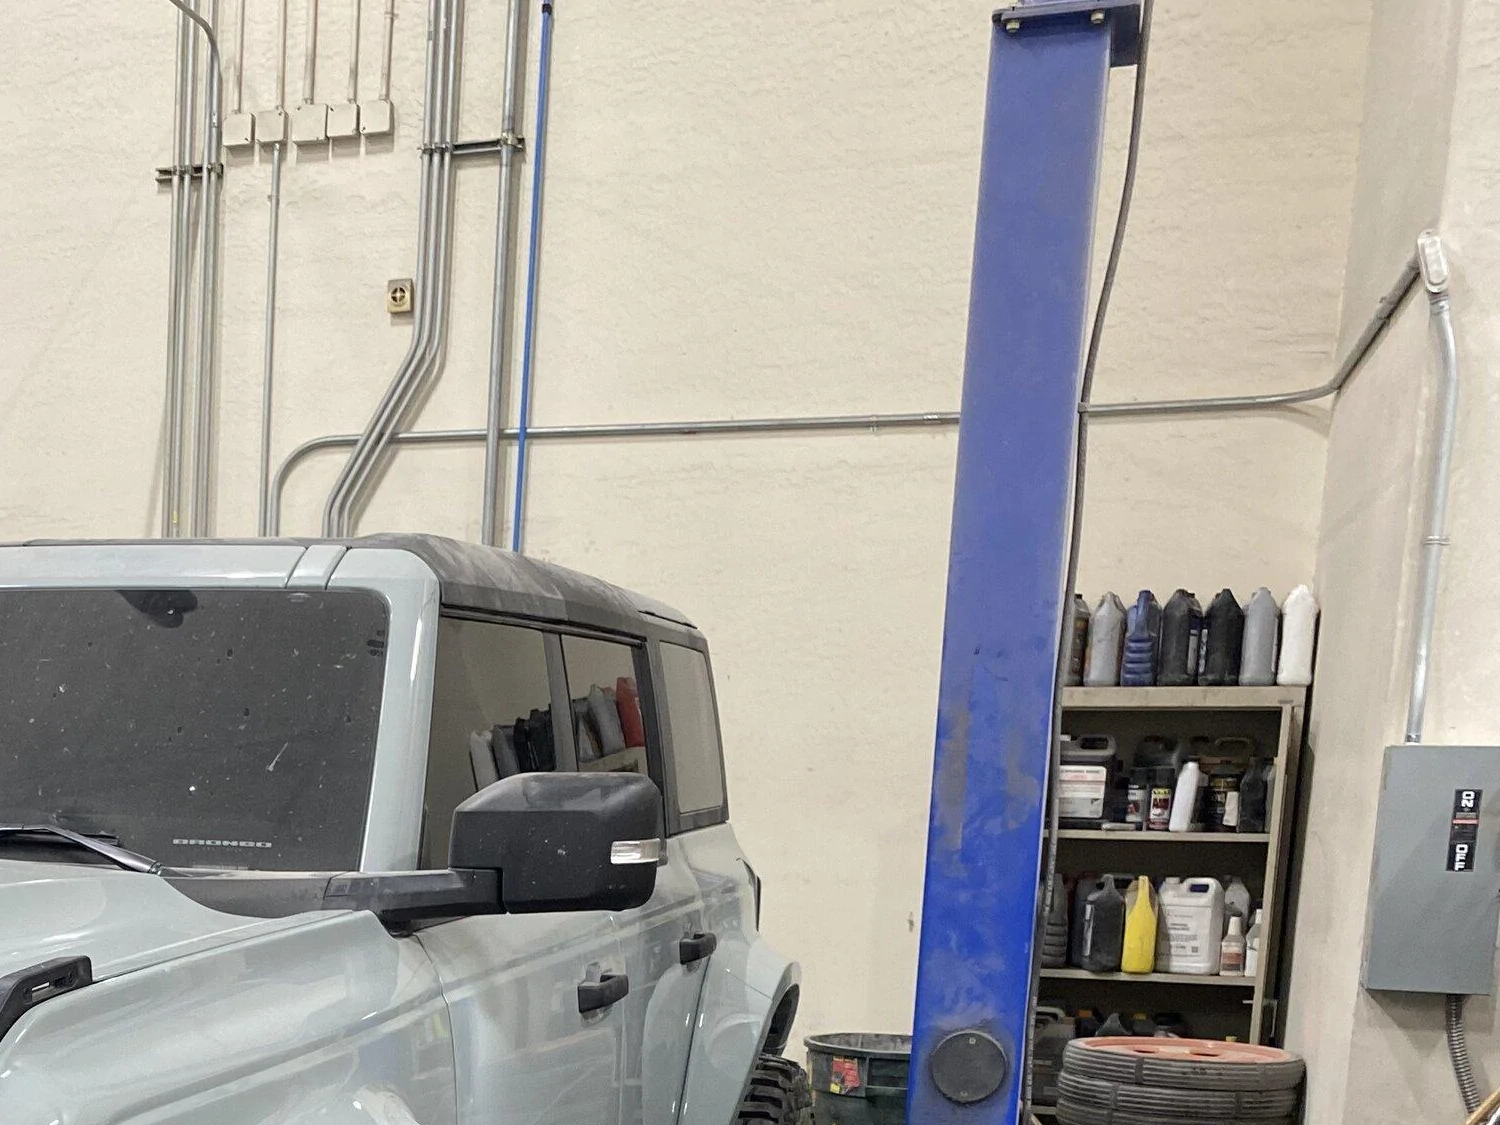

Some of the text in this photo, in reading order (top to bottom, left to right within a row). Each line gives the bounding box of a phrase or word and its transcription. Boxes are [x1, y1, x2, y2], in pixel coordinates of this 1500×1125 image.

[1461, 790, 1475, 807] ON
[172, 838, 272, 848] BRONCO
[1454, 844, 1468, 871] OFF
